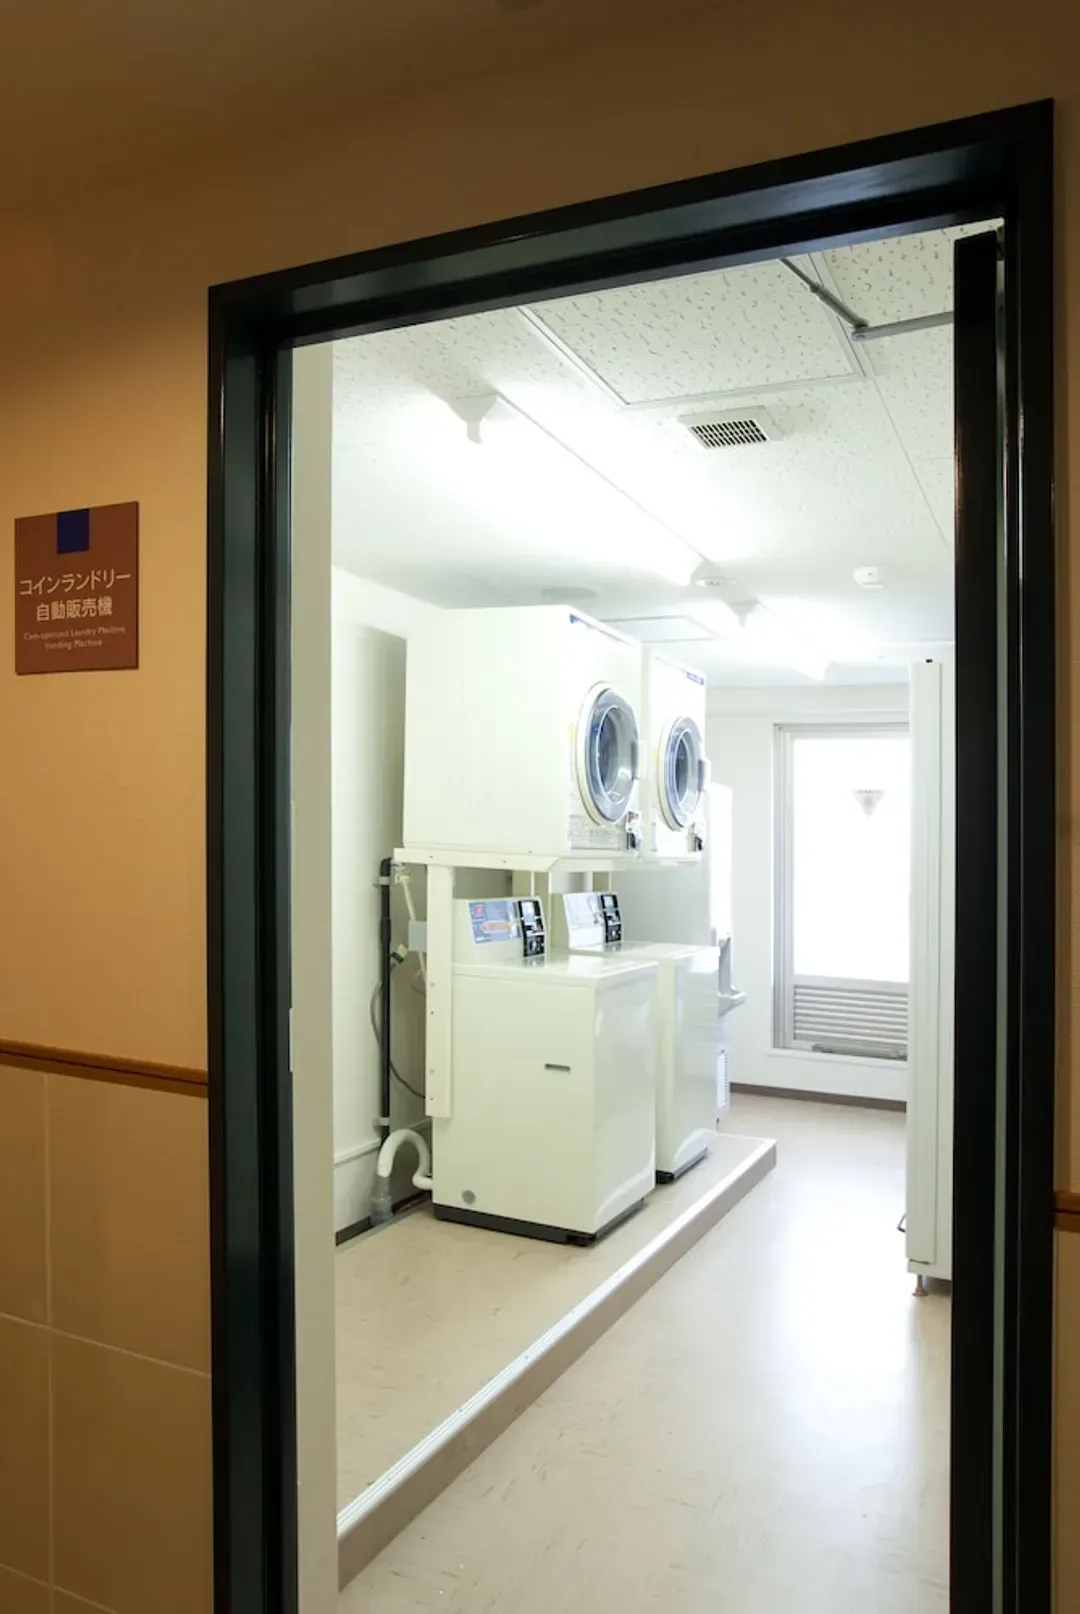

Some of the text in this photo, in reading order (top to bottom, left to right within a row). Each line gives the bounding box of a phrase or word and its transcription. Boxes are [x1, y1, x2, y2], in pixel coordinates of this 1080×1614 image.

[20, 568, 131, 595] コインランドリー
[37, 596, 113, 621] 自動販売機
